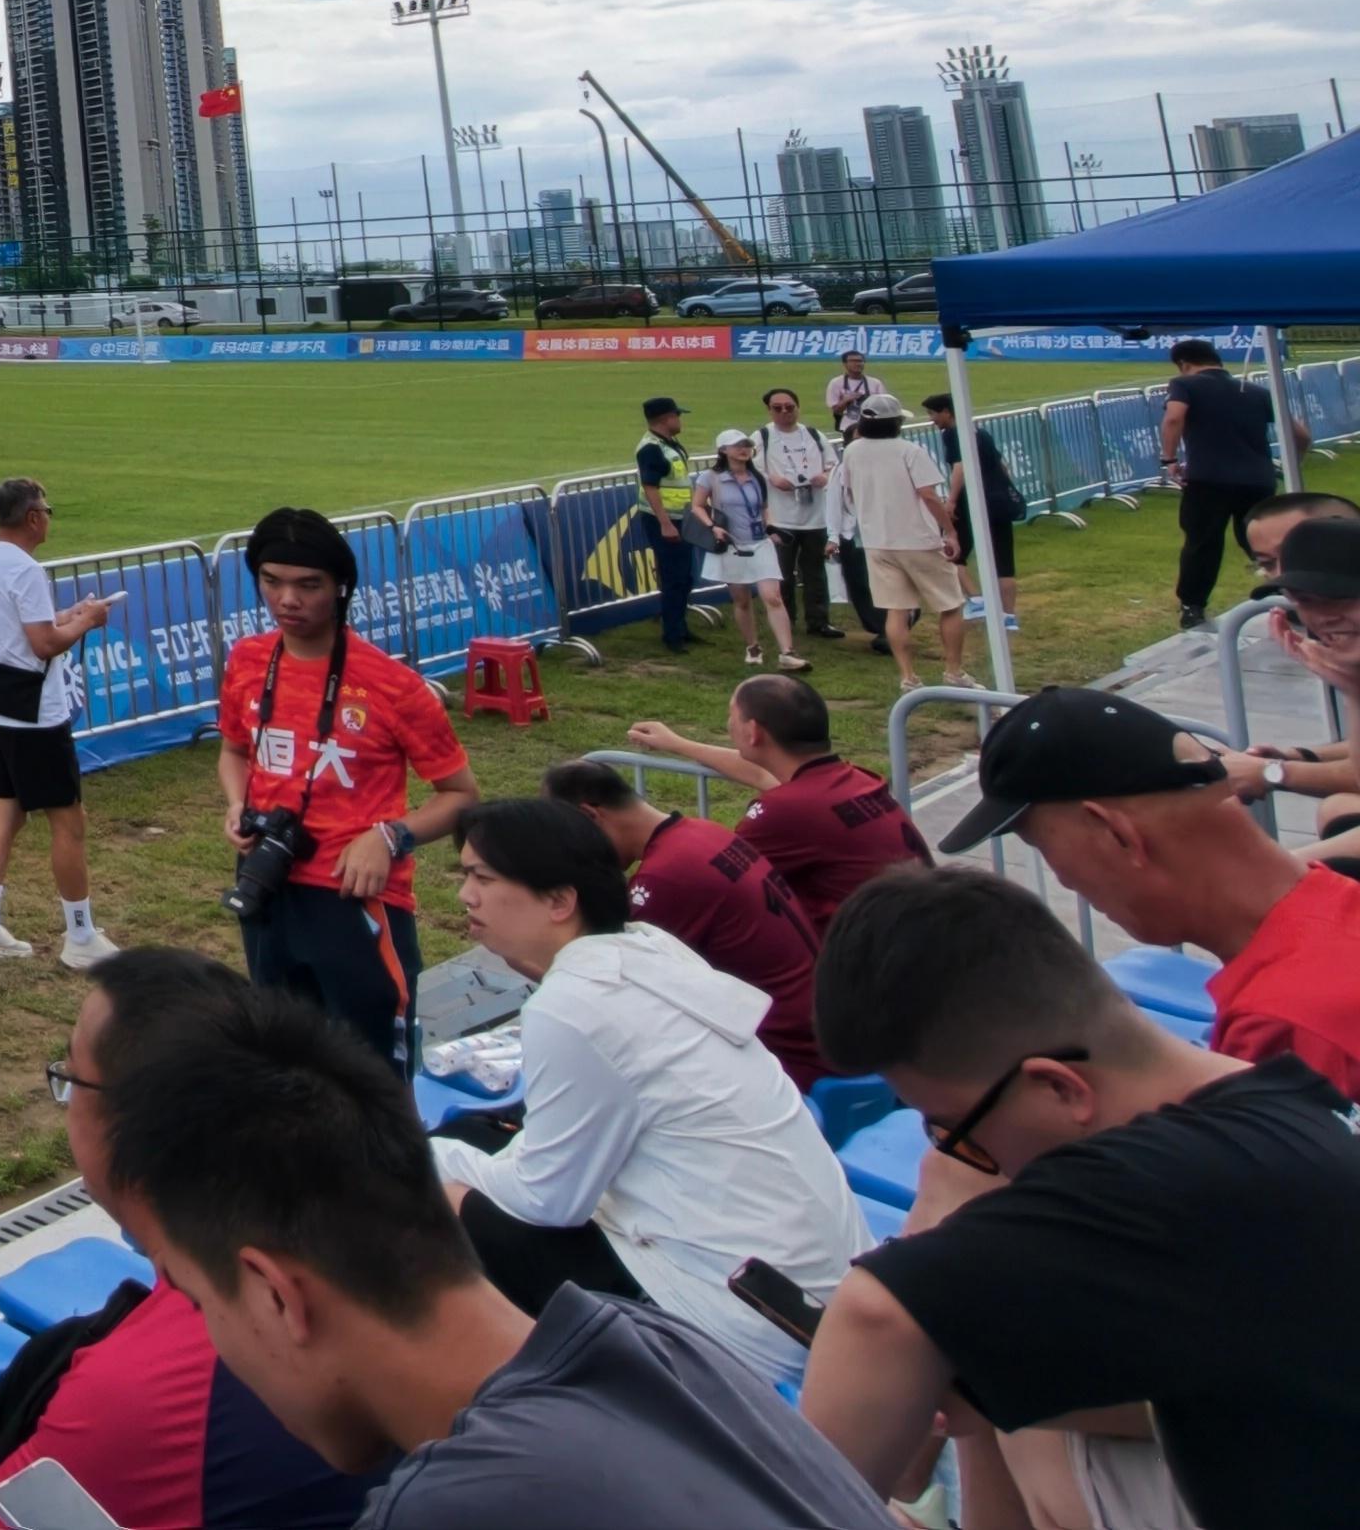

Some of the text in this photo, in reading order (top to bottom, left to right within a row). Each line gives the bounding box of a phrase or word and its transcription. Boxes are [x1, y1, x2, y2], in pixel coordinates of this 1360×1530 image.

[536, 335, 716, 351] 发展体育运动 增强人民体质
[865, 329, 947, 356] 选威
[84, 640, 142, 675] CMCL
[251, 727, 357, 788] 恒大
